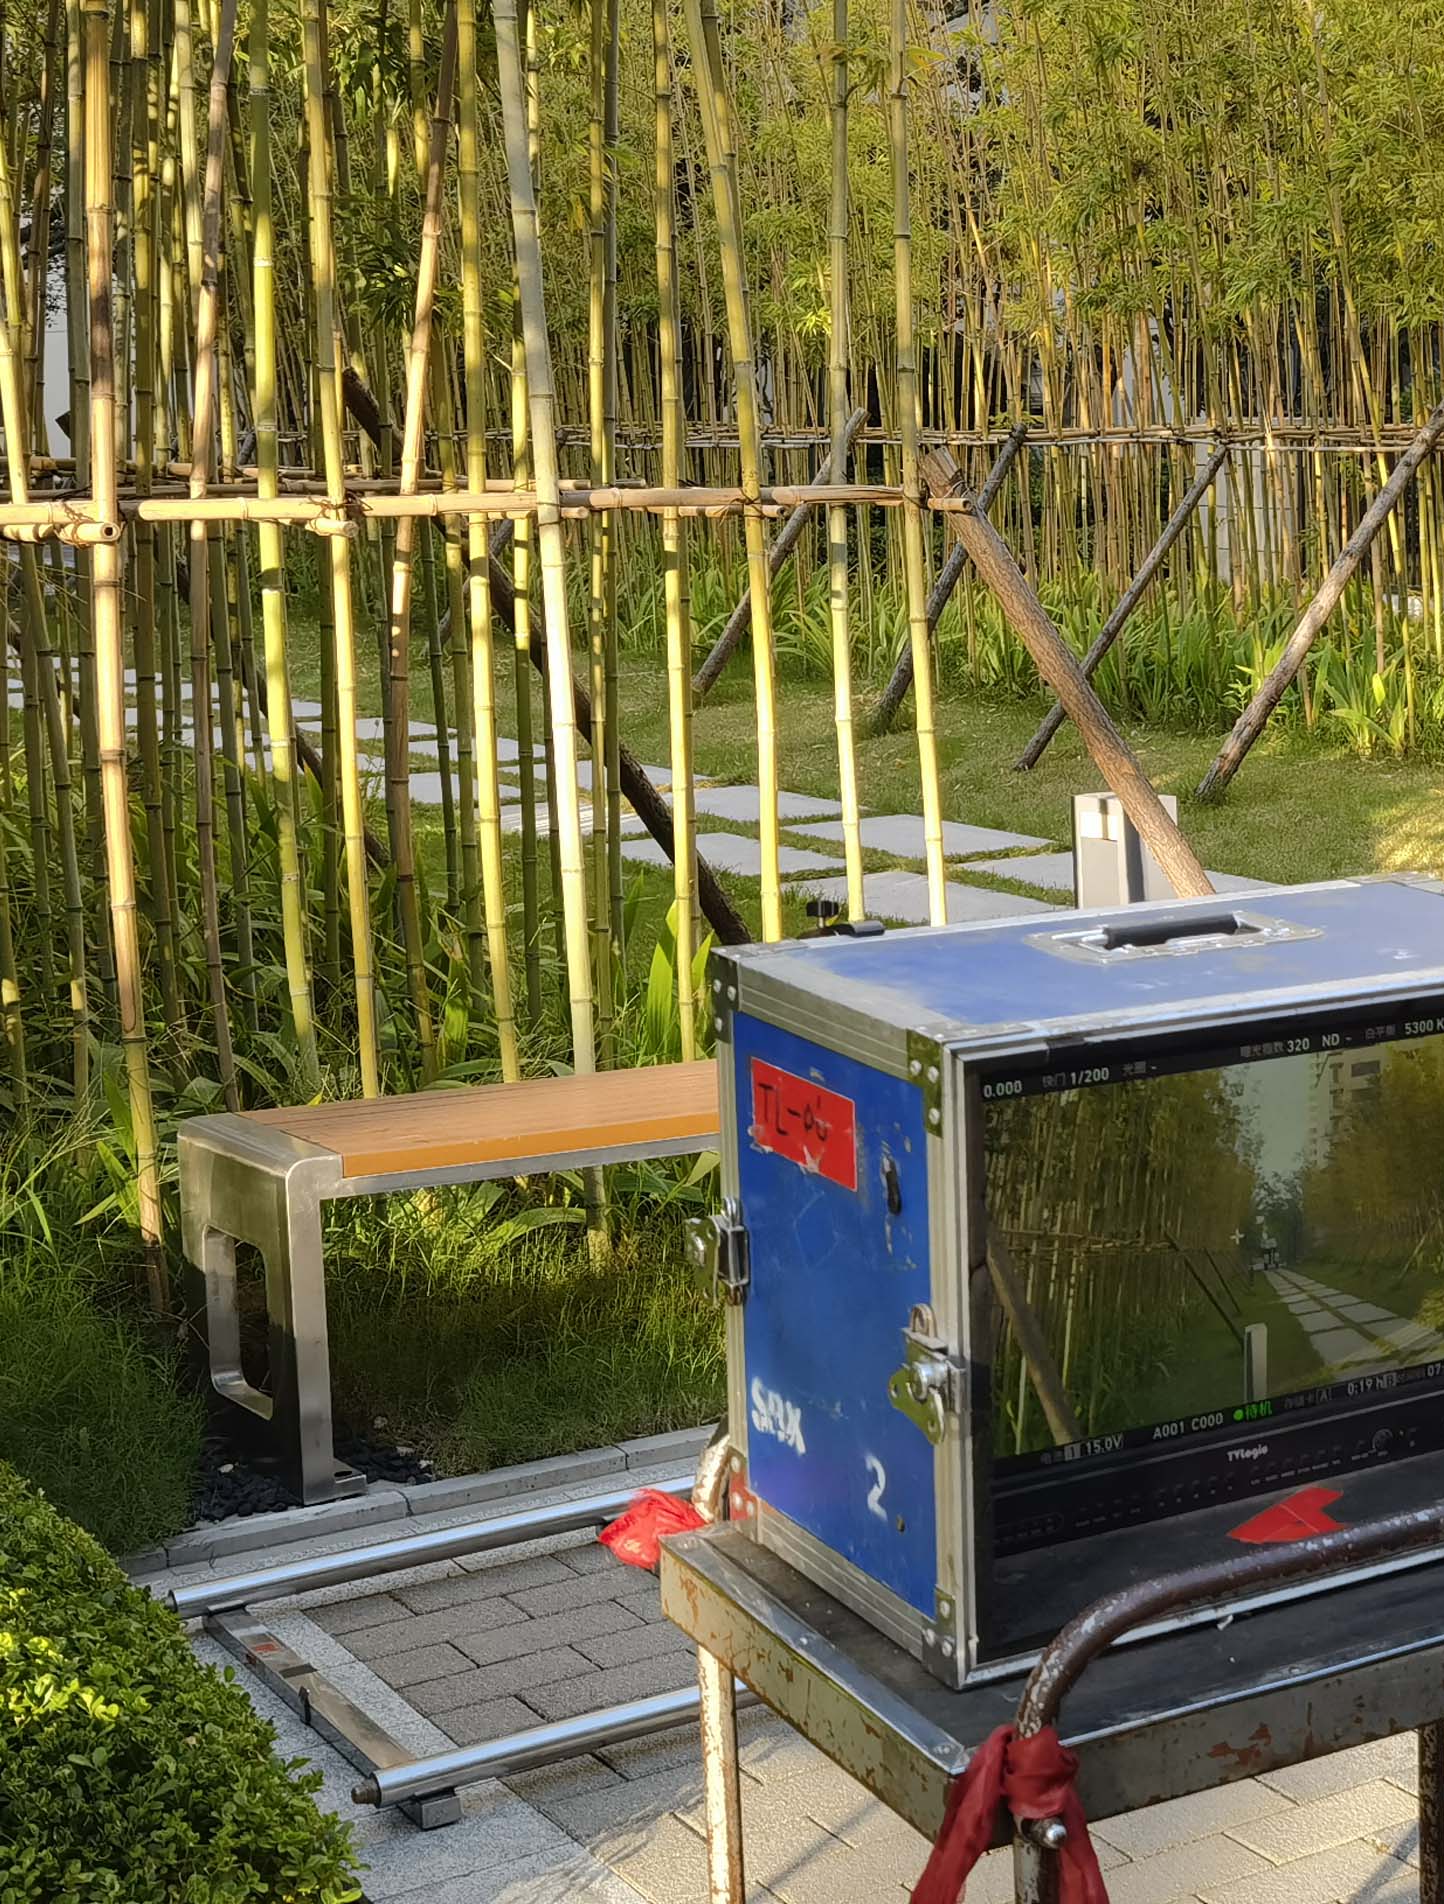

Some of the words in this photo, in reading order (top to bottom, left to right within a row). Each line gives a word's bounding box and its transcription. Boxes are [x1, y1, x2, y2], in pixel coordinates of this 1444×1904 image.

[983, 1080, 1023, 1099] 0.000
[1070, 1067, 1110, 1085] 1/200
[1287, 1037, 1311, 1054] 320
[1321, 1033, 1340, 1049] ND
[1404, 1020, 1434, 1036] 5300
[1153, 1420, 1185, 1440] A001
[1191, 1412, 1224, 1432] C000
[864, 1453, 888, 1521] 2
